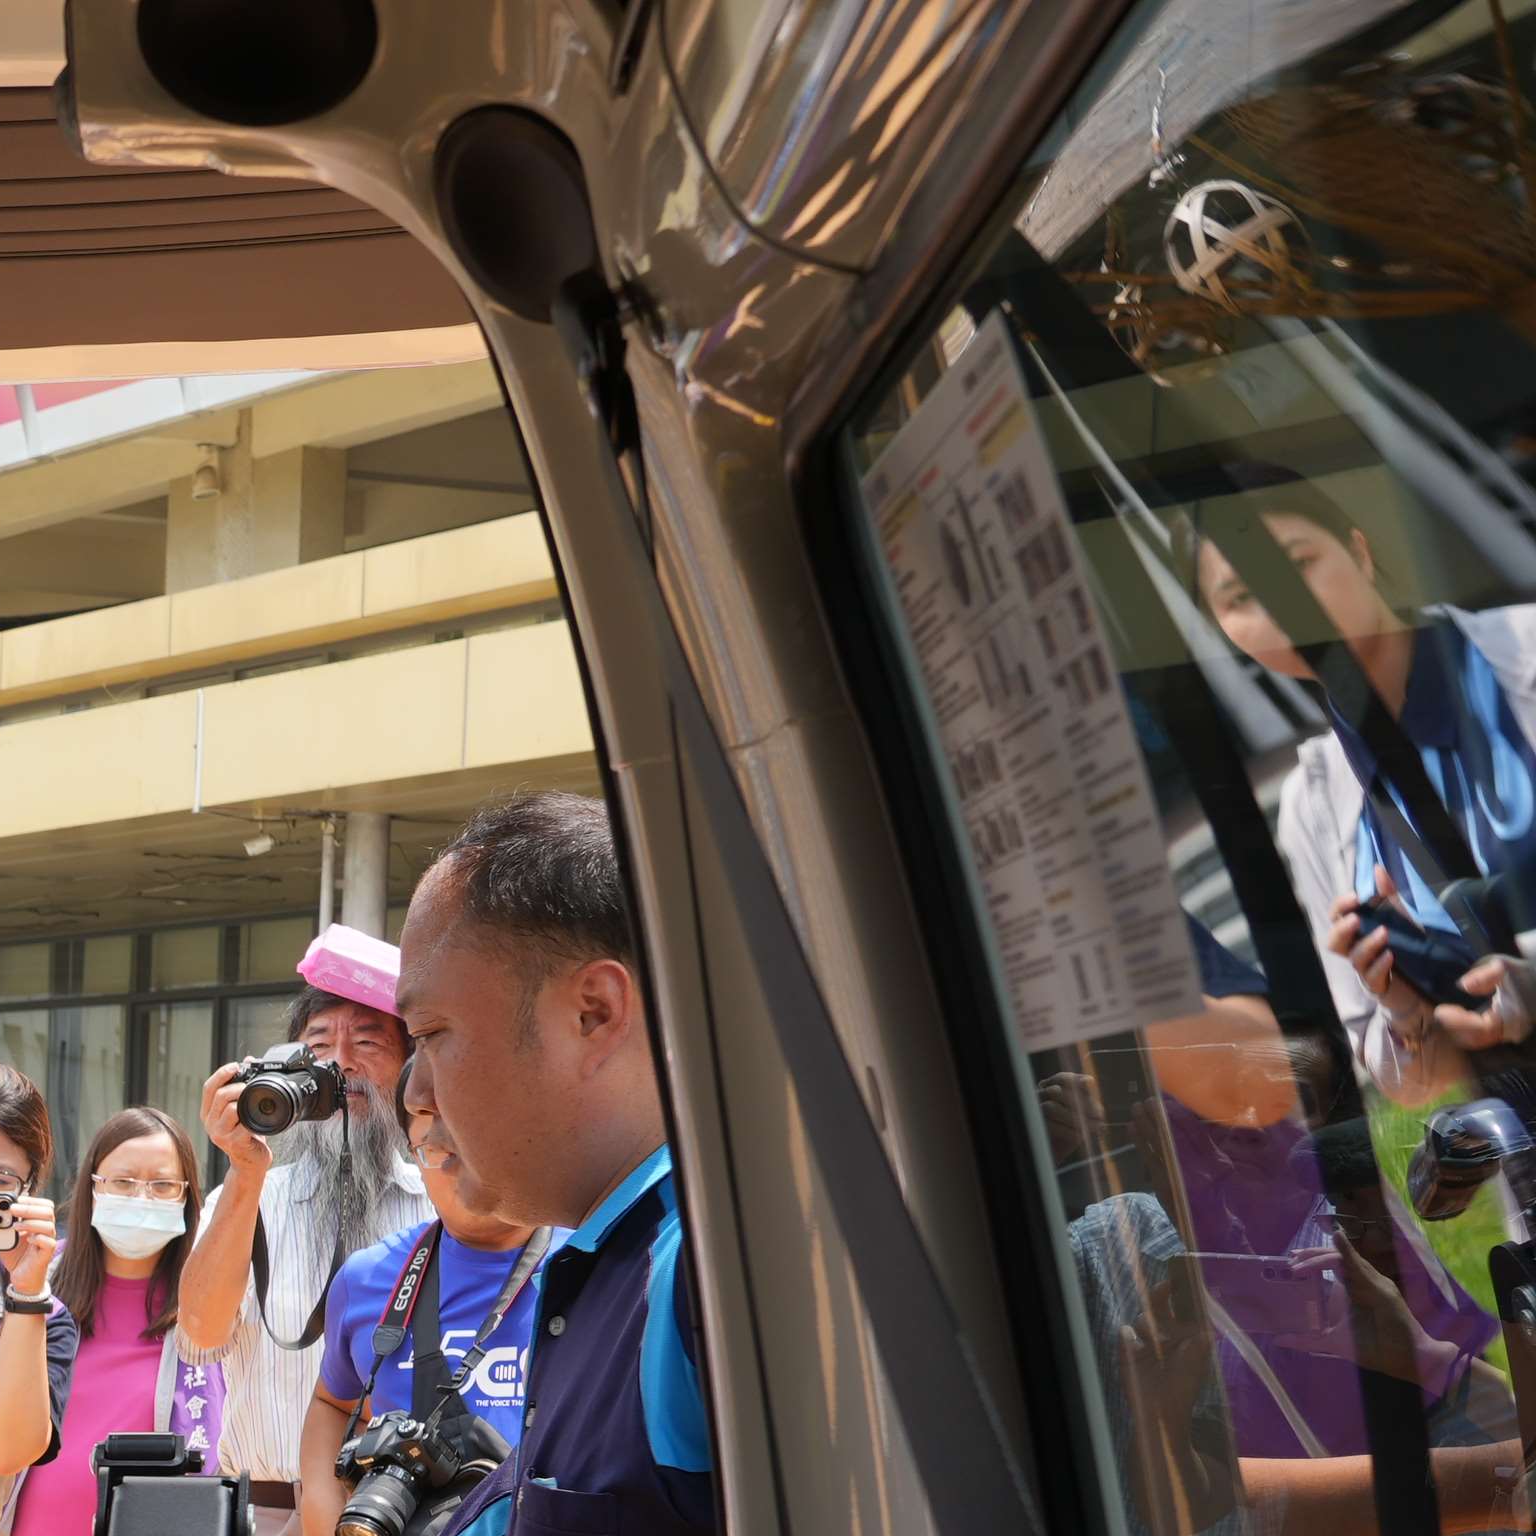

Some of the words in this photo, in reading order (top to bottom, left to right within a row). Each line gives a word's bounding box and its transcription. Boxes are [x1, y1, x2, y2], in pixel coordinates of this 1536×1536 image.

[394, 1274, 417, 1311] EOS
[409, 1247, 429, 1273] 70D
[183, 1366, 210, 1450] 社會處
[475, 1399, 489, 1407] THE
[490, 1399, 511, 1407] VOICE
